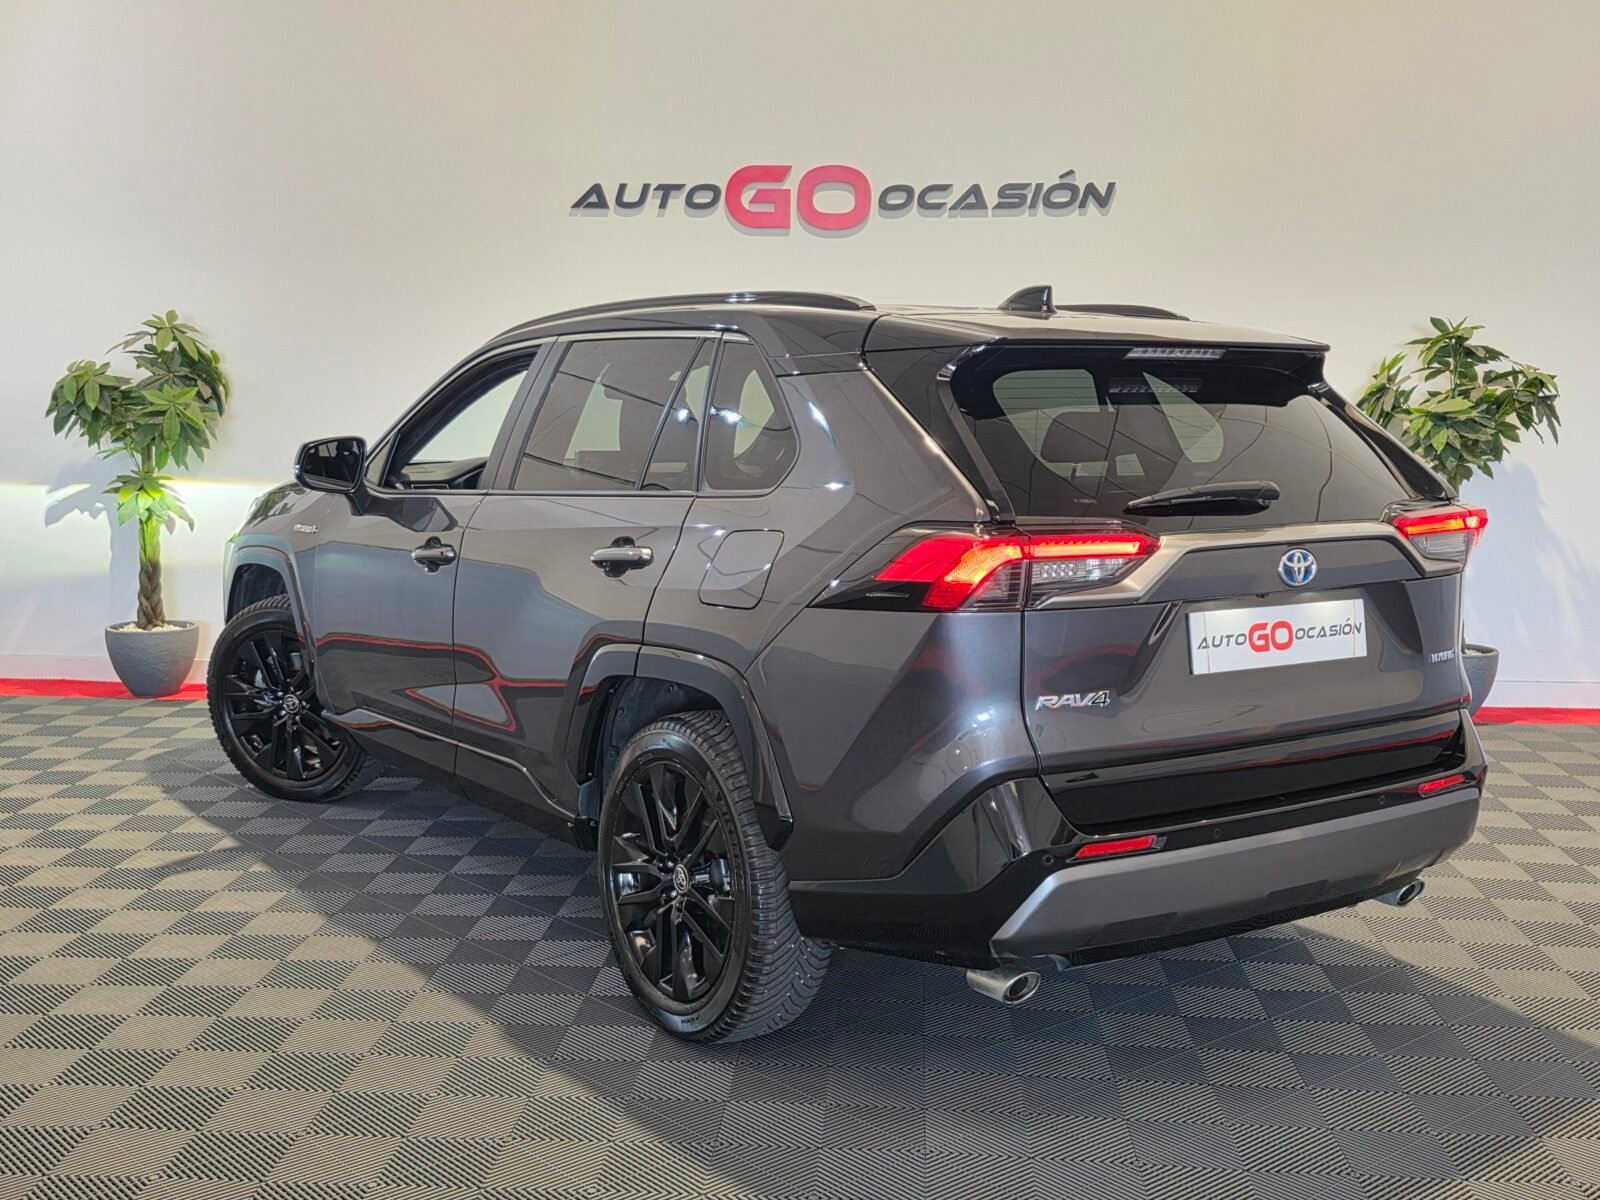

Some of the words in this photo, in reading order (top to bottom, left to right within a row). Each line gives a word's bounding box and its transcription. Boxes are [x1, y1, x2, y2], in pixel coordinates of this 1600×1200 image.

[569, 182, 722, 212] AUTO
[724, 164, 872, 232] GO
[877, 168, 1117, 213] OCASIÓN
[1197, 633, 1247, 650] AUTO
[1248, 620, 1294, 652] GO
[1295, 617, 1362, 640] OCASIÓN
[1035, 690, 1110, 711] RAV4
